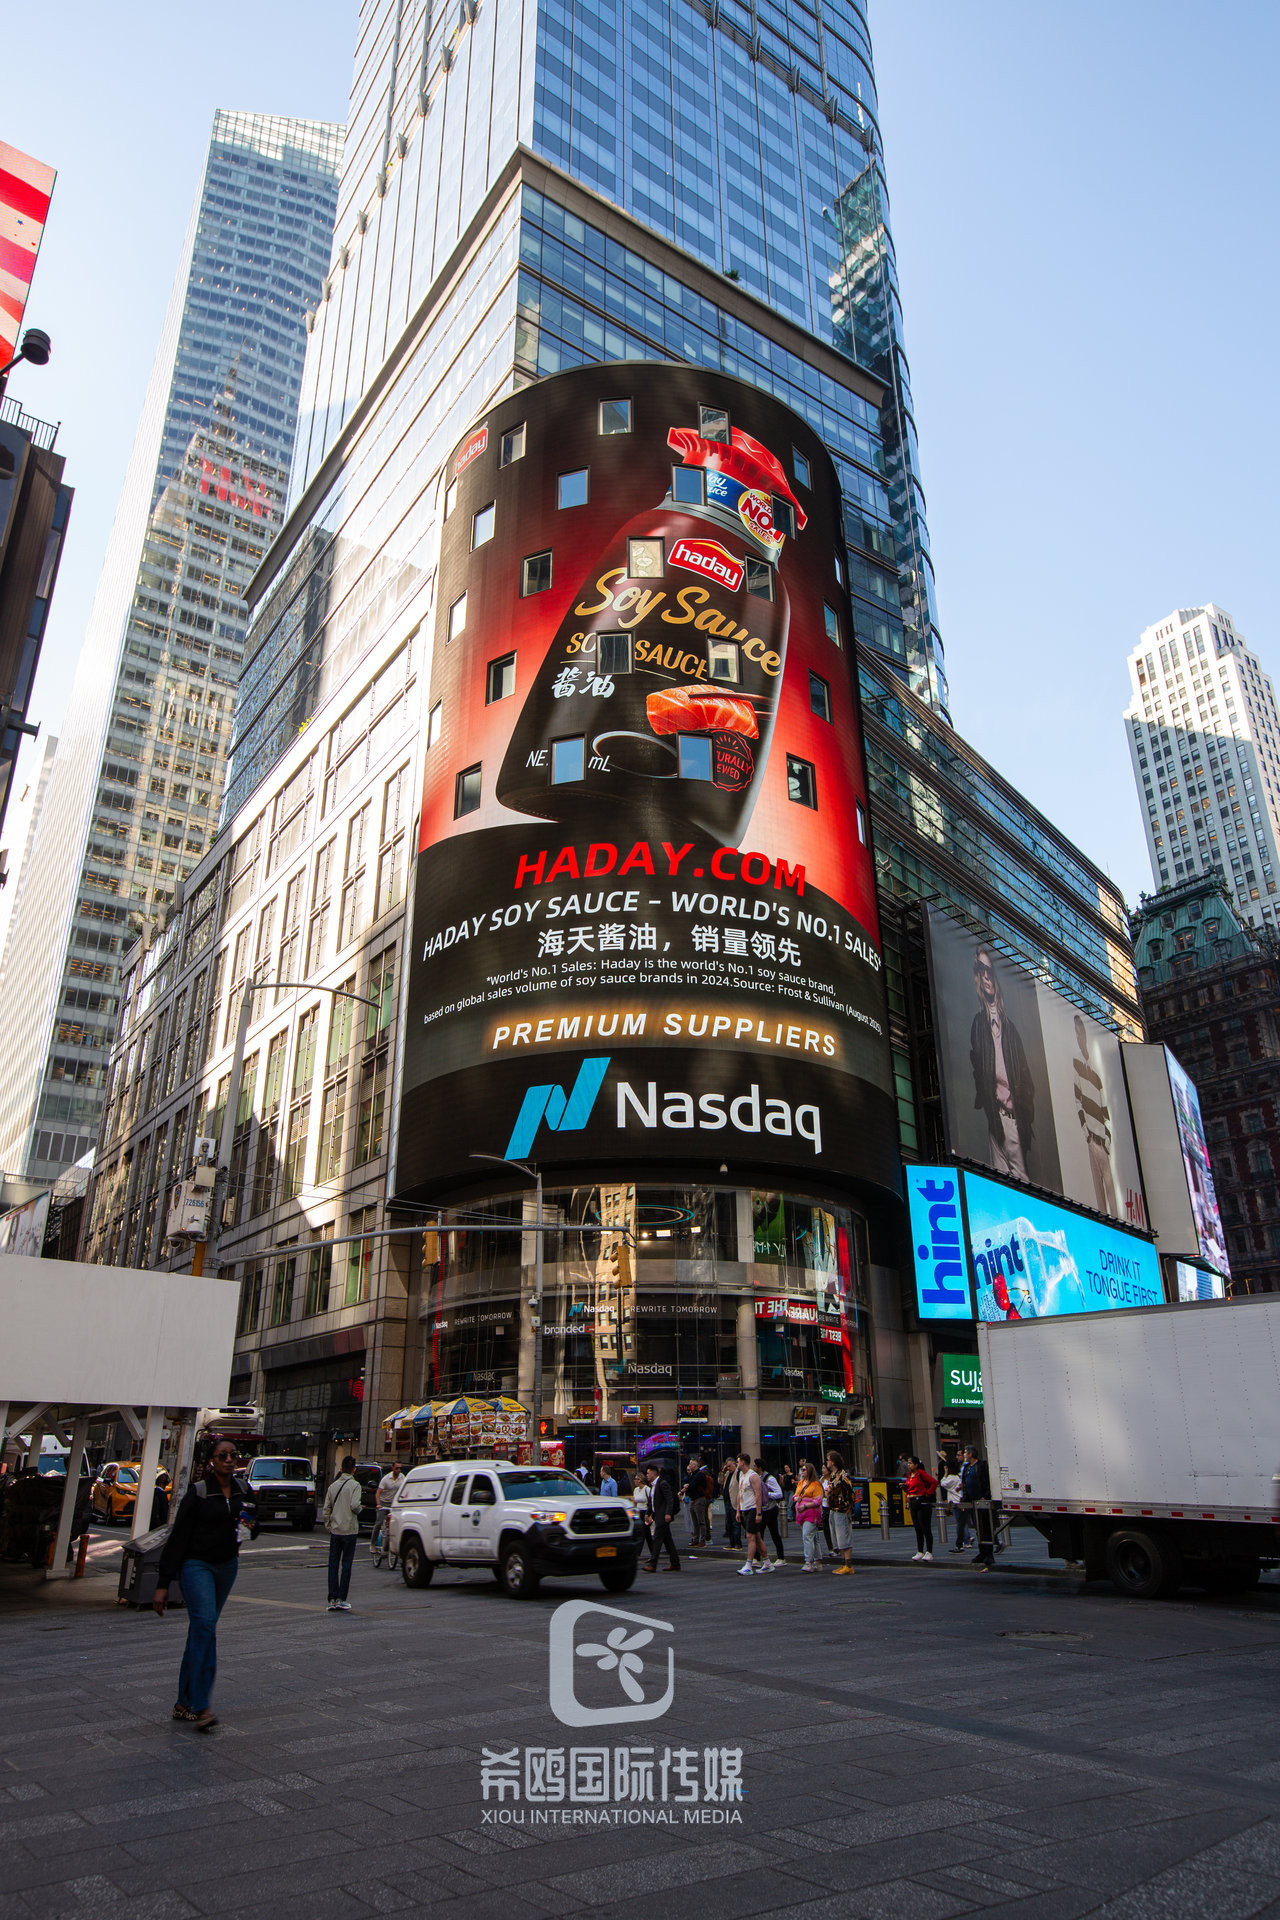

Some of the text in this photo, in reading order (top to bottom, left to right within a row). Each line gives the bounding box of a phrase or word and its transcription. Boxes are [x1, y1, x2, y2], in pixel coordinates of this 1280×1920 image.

[748, 521, 772, 545] SALES
[675, 543, 739, 587] haday
[574, 567, 781, 677] Soy Sauce
[565, 632, 596, 654] SO
[716, 750, 751, 775] URALLY
[716, 763, 740, 781] EWED
[513, 841, 807, 897] HADAY.COM
[422, 913, 487, 961] HADAY
[489, 899, 542, 932] SOY
[545, 890, 641, 919] SAUCE
[671, 891, 790, 927] WORLD'S
[796, 911, 841, 944] NO.1
[531, 964, 557, 978] No.1
[561, 961, 597, 974] Sales:
[601, 958, 641, 971] Haday
[644, 958, 655, 969] is
[657, 958, 678, 969] the
[680, 959, 725, 972] world's
[728, 963, 753, 976] No.1
[757, 967, 776, 981] soy
[778, 972, 806, 986] sauce
[808, 977, 836, 997] brand,
[424, 1006, 444, 1025] based
[444, 1002, 455, 1014] on
[456, 991, 485, 1012] global
[487, 985, 513, 1001] sales
[515, 979, 557, 995] volume
[560, 977, 573, 988] of
[575, 975, 597, 988] soy
[600, 974, 636, 985] sauce
[639, 972, 683, 984] brands
[687, 973, 698, 984] in
[778, 984, 803, 999] Frost
[804, 991, 812, 1001] &
[813, 992, 845, 1013] Sullivan
[492, 1013, 837, 1057] PREMIUM SUPPLIERS
[616, 1081, 823, 1155] Nasdaq
[1125, 1187, 1145, 1228] H&M
[917, 1179, 966, 1305] hint
[1099, 1249, 1141, 1282] DRINK IT
[1086, 1270, 1158, 1307] TONGUE FIRST
[477, 1311, 513, 1322] TOMORROW
[583, 1303, 615, 1314] Nasdaq
[630, 1305, 718, 1314] REWRITE TOMORROW
[628, 1362, 672, 1377] Nasdaq
